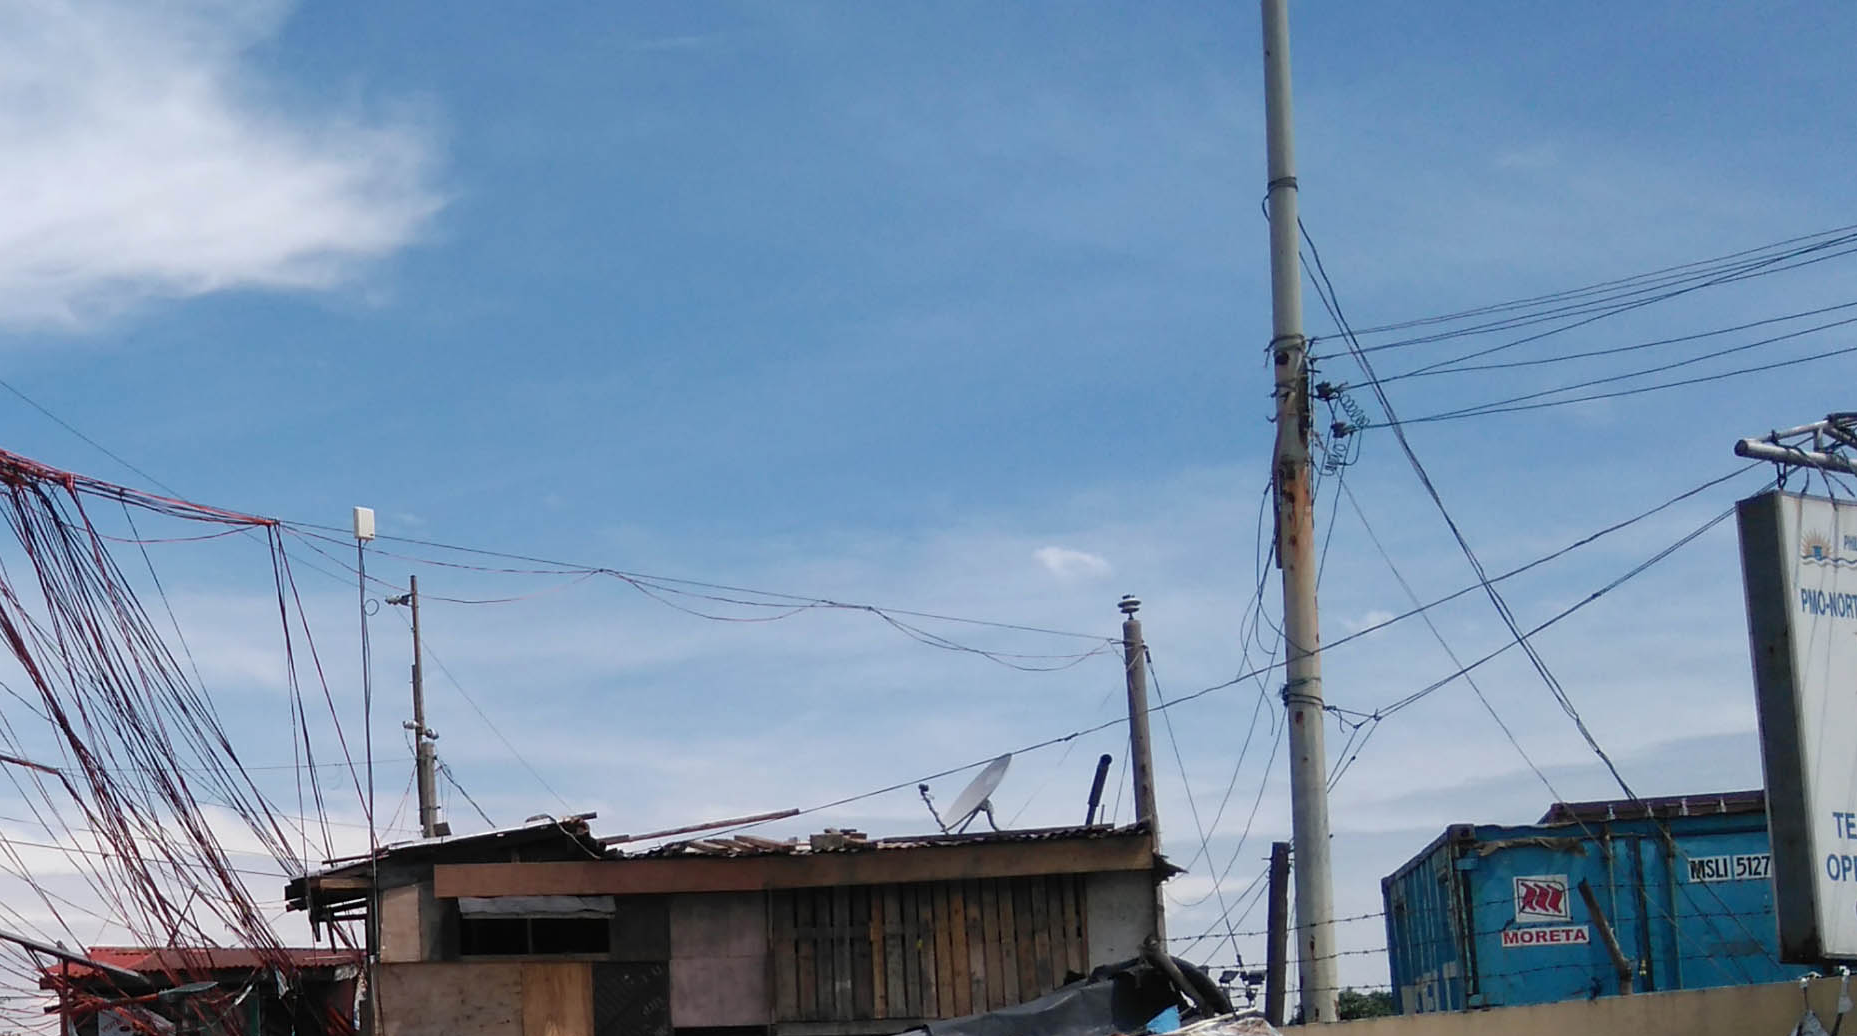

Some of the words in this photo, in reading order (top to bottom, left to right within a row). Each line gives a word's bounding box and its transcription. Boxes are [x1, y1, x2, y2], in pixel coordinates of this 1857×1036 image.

[1690, 857, 1729, 880] MSLI
[1735, 855, 1771, 878] 5127
[1826, 853, 1857, 882] OP
[1503, 928, 1588, 945] MORETA
